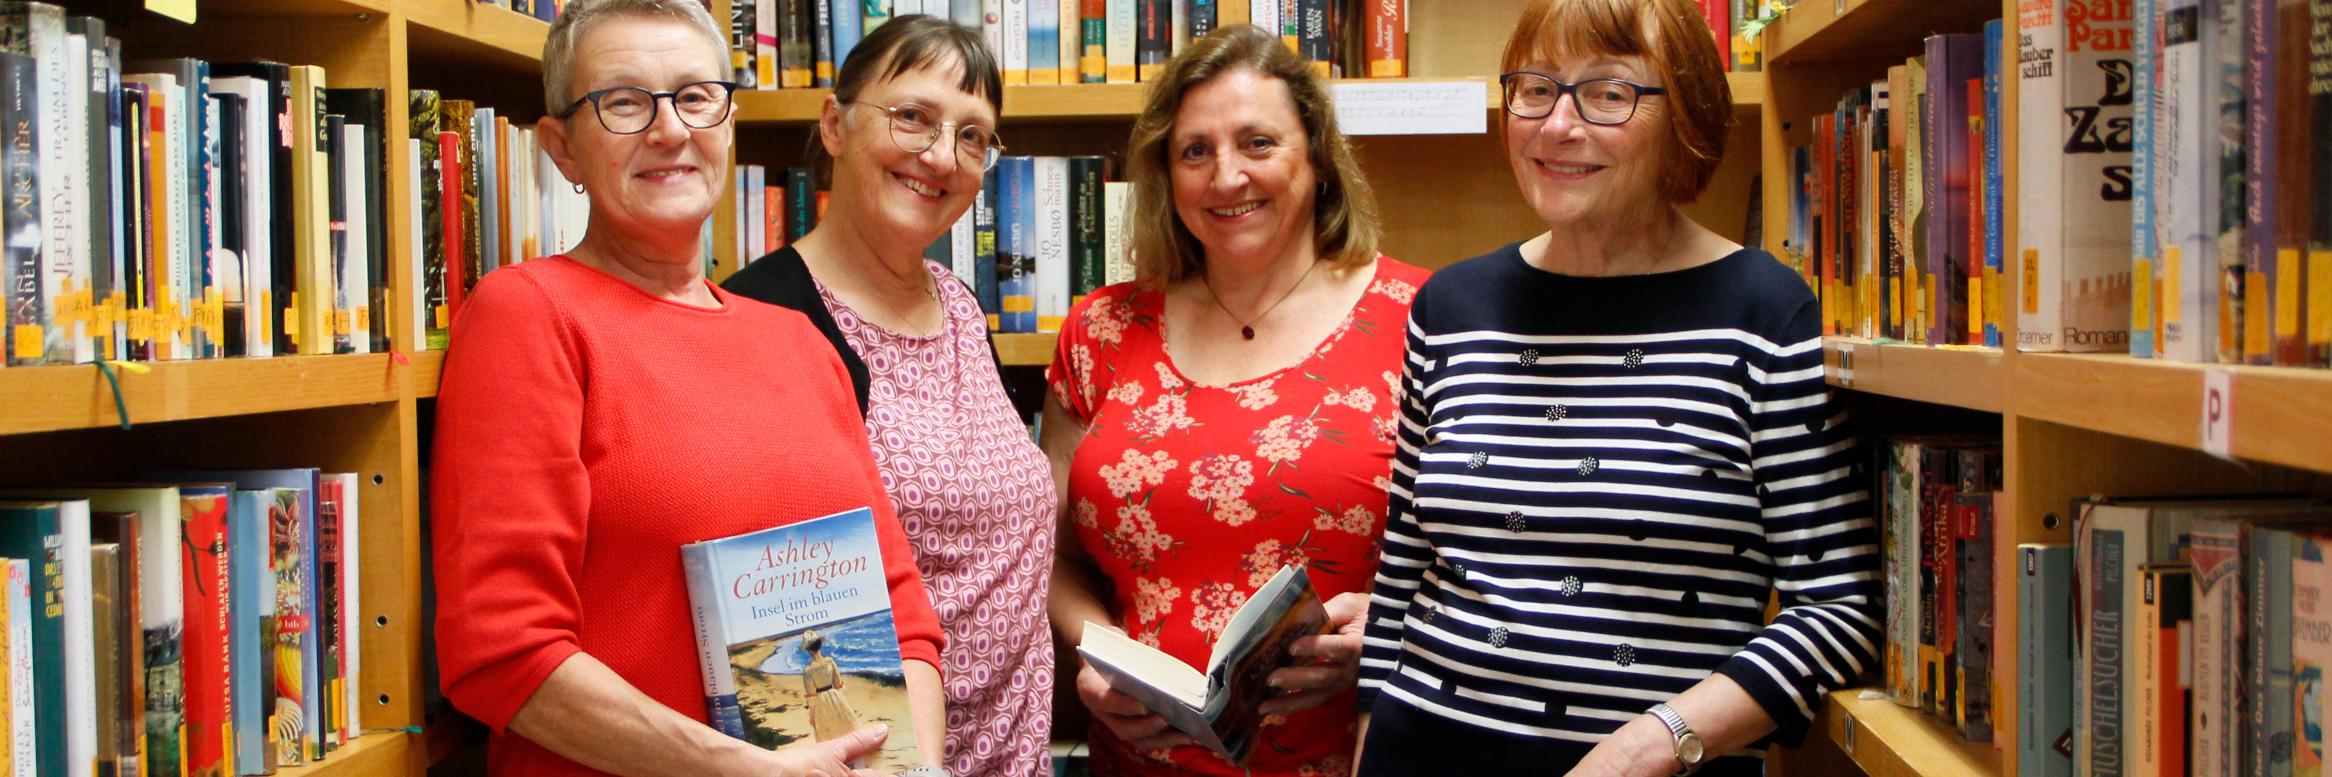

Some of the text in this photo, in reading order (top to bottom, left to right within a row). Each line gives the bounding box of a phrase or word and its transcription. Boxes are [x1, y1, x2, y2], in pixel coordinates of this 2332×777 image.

[1306, 8, 1316, 40] KAREN
[1314, 9, 1323, 37] SWAN
[2022, 62, 2053, 79] schiff
[2250, 58, 2263, 99] wird
[2134, 72, 2147, 143] SCHULD
[2252, 104, 2267, 174] sonntags
[471, 155, 479, 186] INKA
[1042, 165, 1055, 206] Schnee
[1053, 173, 1062, 207] mann
[2134, 146, 2147, 193] ALLE
[2133, 195, 2146, 224] BIS
[2249, 178, 2262, 224] Auch
[1011, 222, 1022, 266] NESBØ
[1040, 239, 1051, 261] JO
[1051, 210, 1063, 260] NESBØ
[1108, 215, 1119, 265] NICHOLLS
[1011, 267, 1023, 286] JO
[2064, 327, 2128, 345] Roman
[2208, 388, 2221, 440] P
[756, 536, 836, 571] Ashley
[1937, 503, 1949, 566] Afrika
[215, 531, 226, 632] SCHLAFEN WERDEN
[733, 554, 868, 600] Carrington
[2256, 556, 2265, 631] Zimmer
[284, 619, 299, 629] btb
[751, 585, 859, 620] Insel im blauen
[785, 608, 829, 628] Strom
[697, 606, 710, 650] Strom
[704, 651, 719, 696] blauen
[2256, 635, 2264, 686] blaue
[223, 676, 232, 722] SUZSA
[23, 720, 33, 768] BAKER
